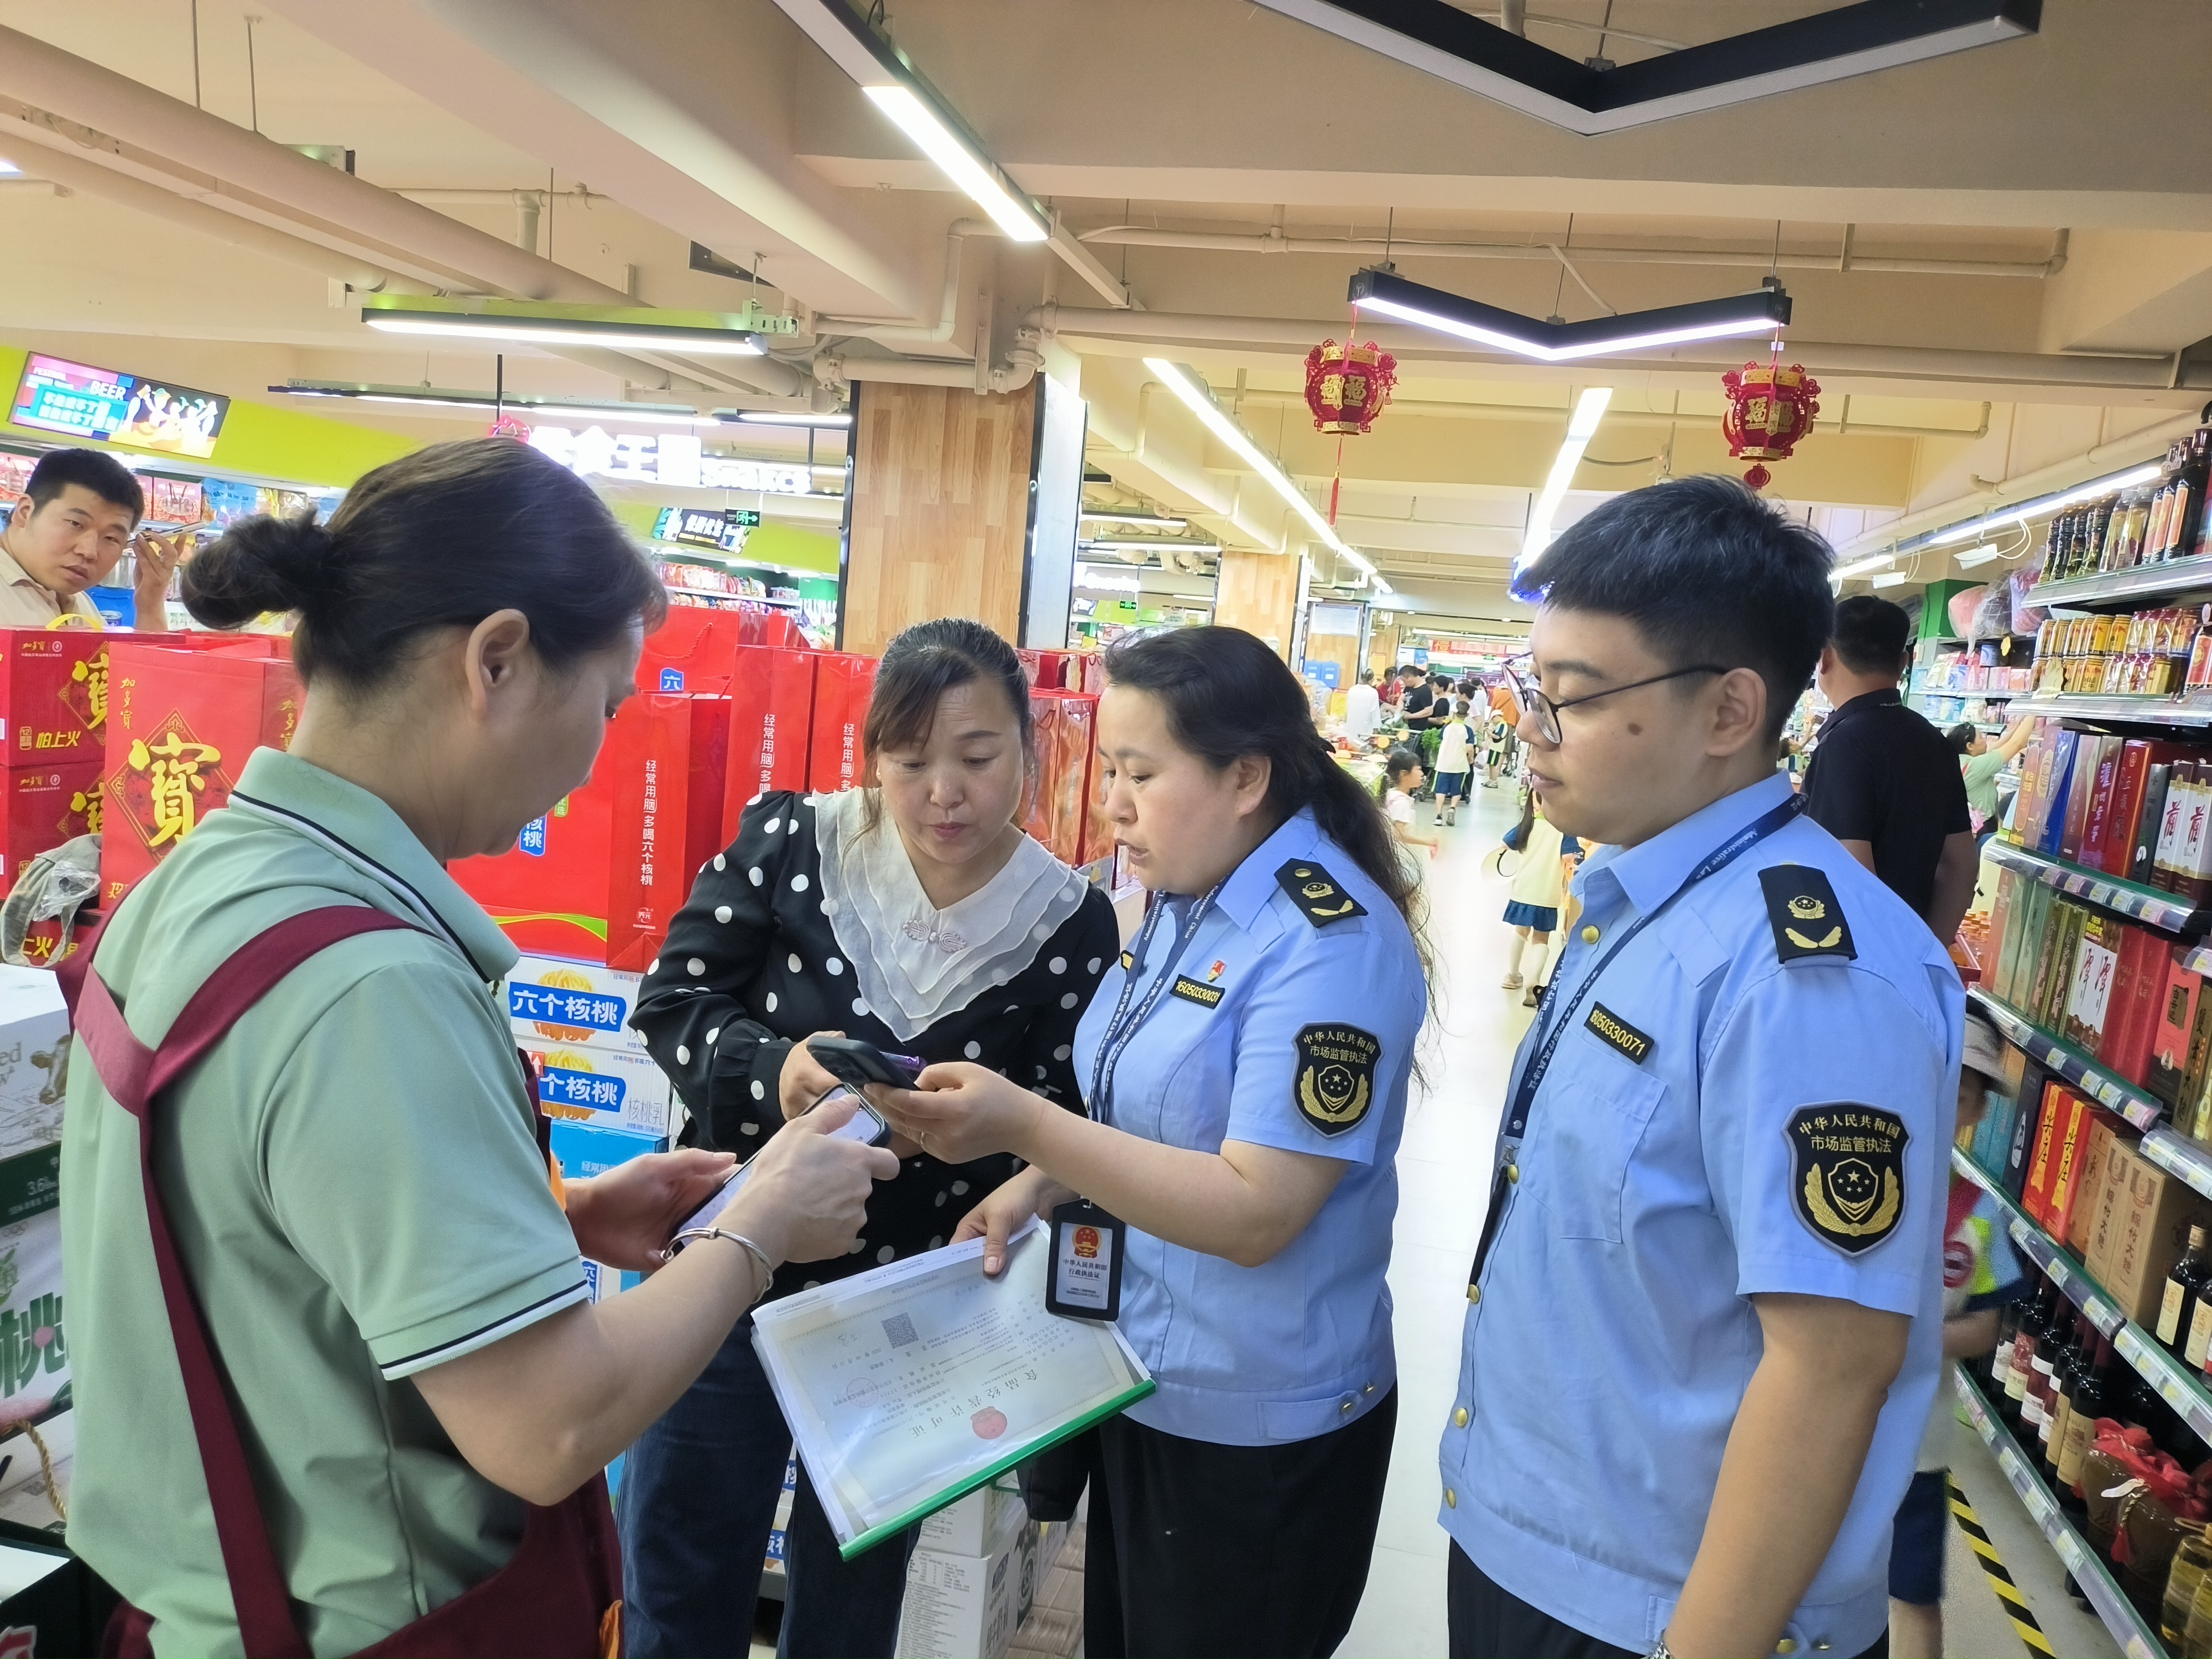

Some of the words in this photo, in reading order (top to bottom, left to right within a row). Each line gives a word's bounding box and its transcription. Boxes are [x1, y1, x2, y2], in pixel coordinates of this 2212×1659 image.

[89, 380, 127, 400] BEER
[664, 675, 681, 690] 六
[35, 731, 81, 749] 怕上火
[840, 722, 854, 791] 经常用脑多
[640, 759, 657, 886] 经常用脑多喝六个核桃
[513, 990, 618, 1025] 六个核桃
[1303, 1031, 1376, 1055] 中华人民共和国
[1310, 1045, 1368, 1065] 市场监管执法
[540, 1073, 618, 1105] 个核桃
[627, 1097, 665, 1125] 核桃乳
[1799, 1114, 1901, 1139] 中华人民共和国
[1811, 1135, 1892, 1153] 市场监管执法
[1063, 1259, 1107, 1271] 中华人民共和国
[1069, 1268, 1100, 1279] 行政执法证
